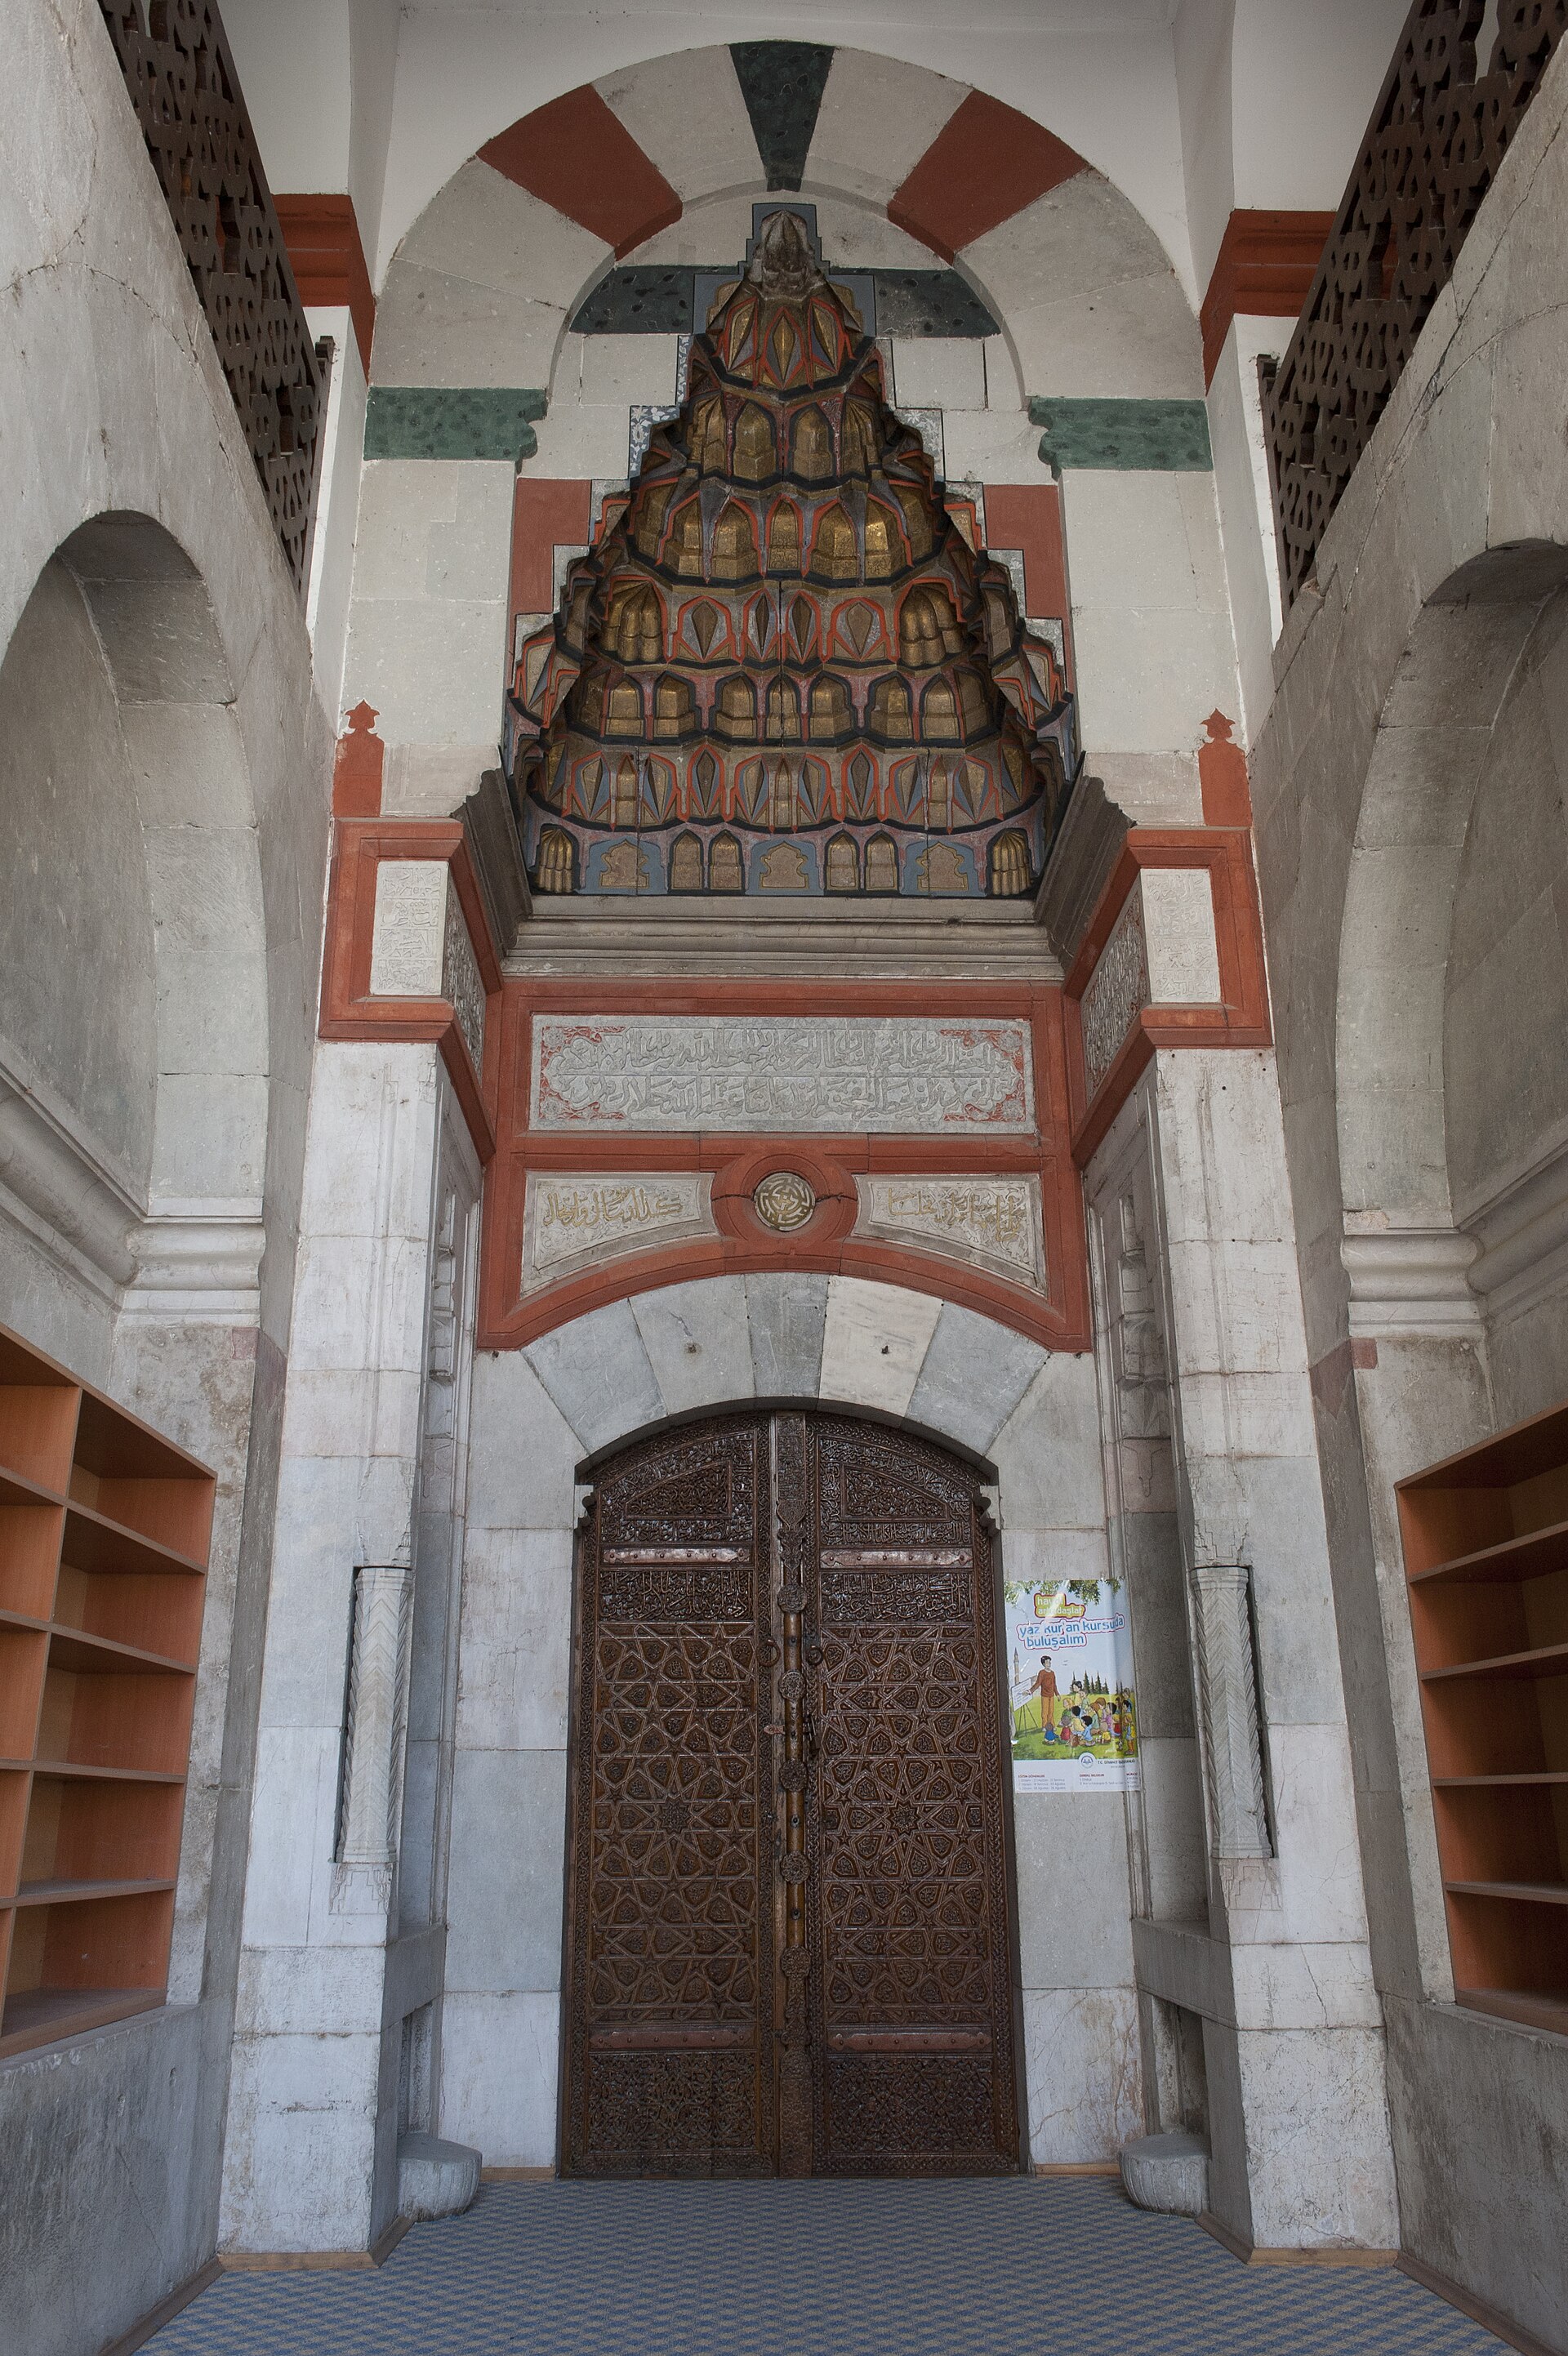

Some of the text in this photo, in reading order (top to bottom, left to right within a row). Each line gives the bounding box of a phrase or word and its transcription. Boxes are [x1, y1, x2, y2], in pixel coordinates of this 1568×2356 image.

[1038, 1606, 1082, 1616] ardaşlar
[1020, 1626, 1040, 1637] yaz
[1083, 1616, 1124, 1631] kursuda
[1027, 1635, 1084, 1648] buluşalım
